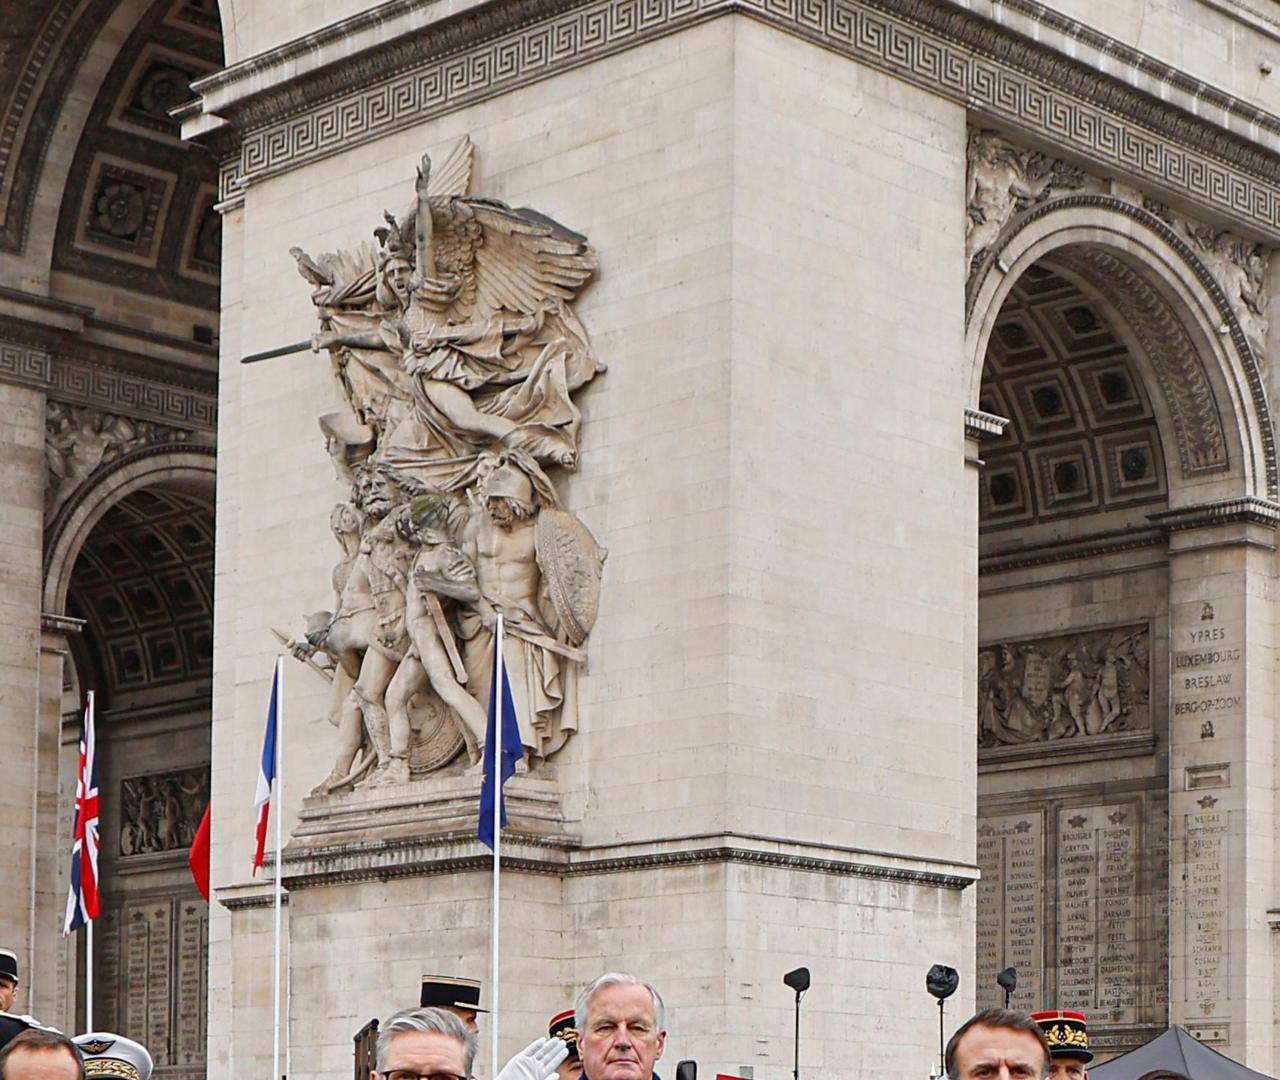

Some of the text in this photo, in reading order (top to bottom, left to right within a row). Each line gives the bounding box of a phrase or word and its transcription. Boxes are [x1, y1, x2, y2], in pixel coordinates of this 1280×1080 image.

[1190, 628, 1225, 643] YPRES
[1176, 650, 1240, 668] LUXEMBOURG
[1185, 674, 1232, 690] BRESLAW
